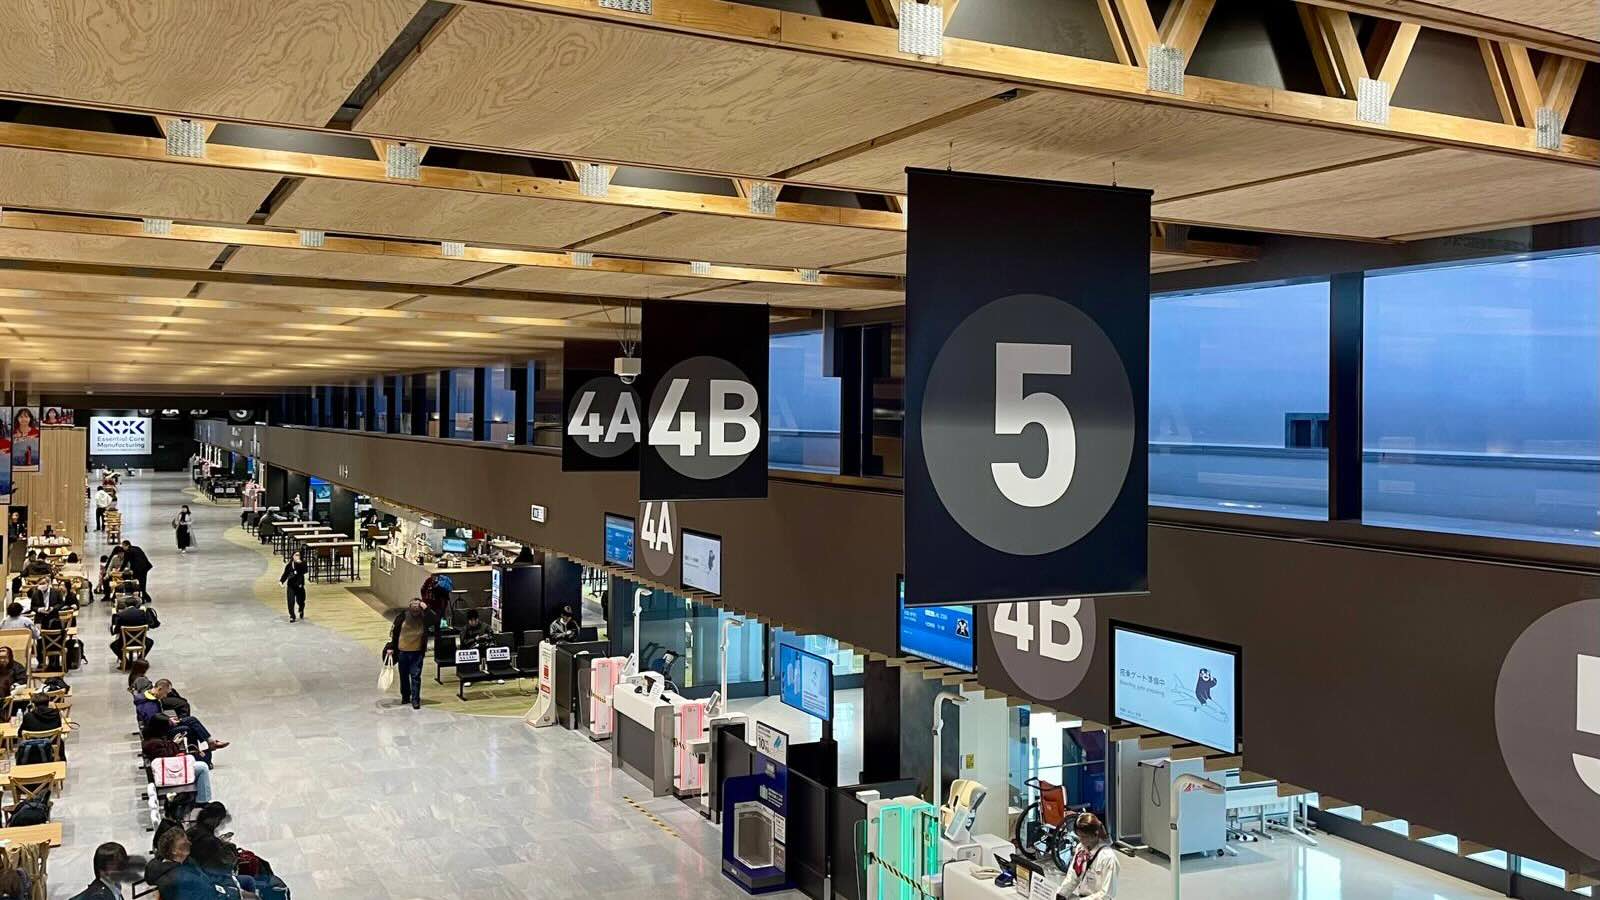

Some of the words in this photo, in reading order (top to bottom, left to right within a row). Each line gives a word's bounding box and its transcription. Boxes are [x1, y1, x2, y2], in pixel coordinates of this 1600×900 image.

[568, 391, 641, 443] 4A
[648, 378, 760, 456] 4B
[991, 342, 1076, 507] 5
[641, 502, 674, 555] 4A
[993, 599, 1083, 662] 4B
